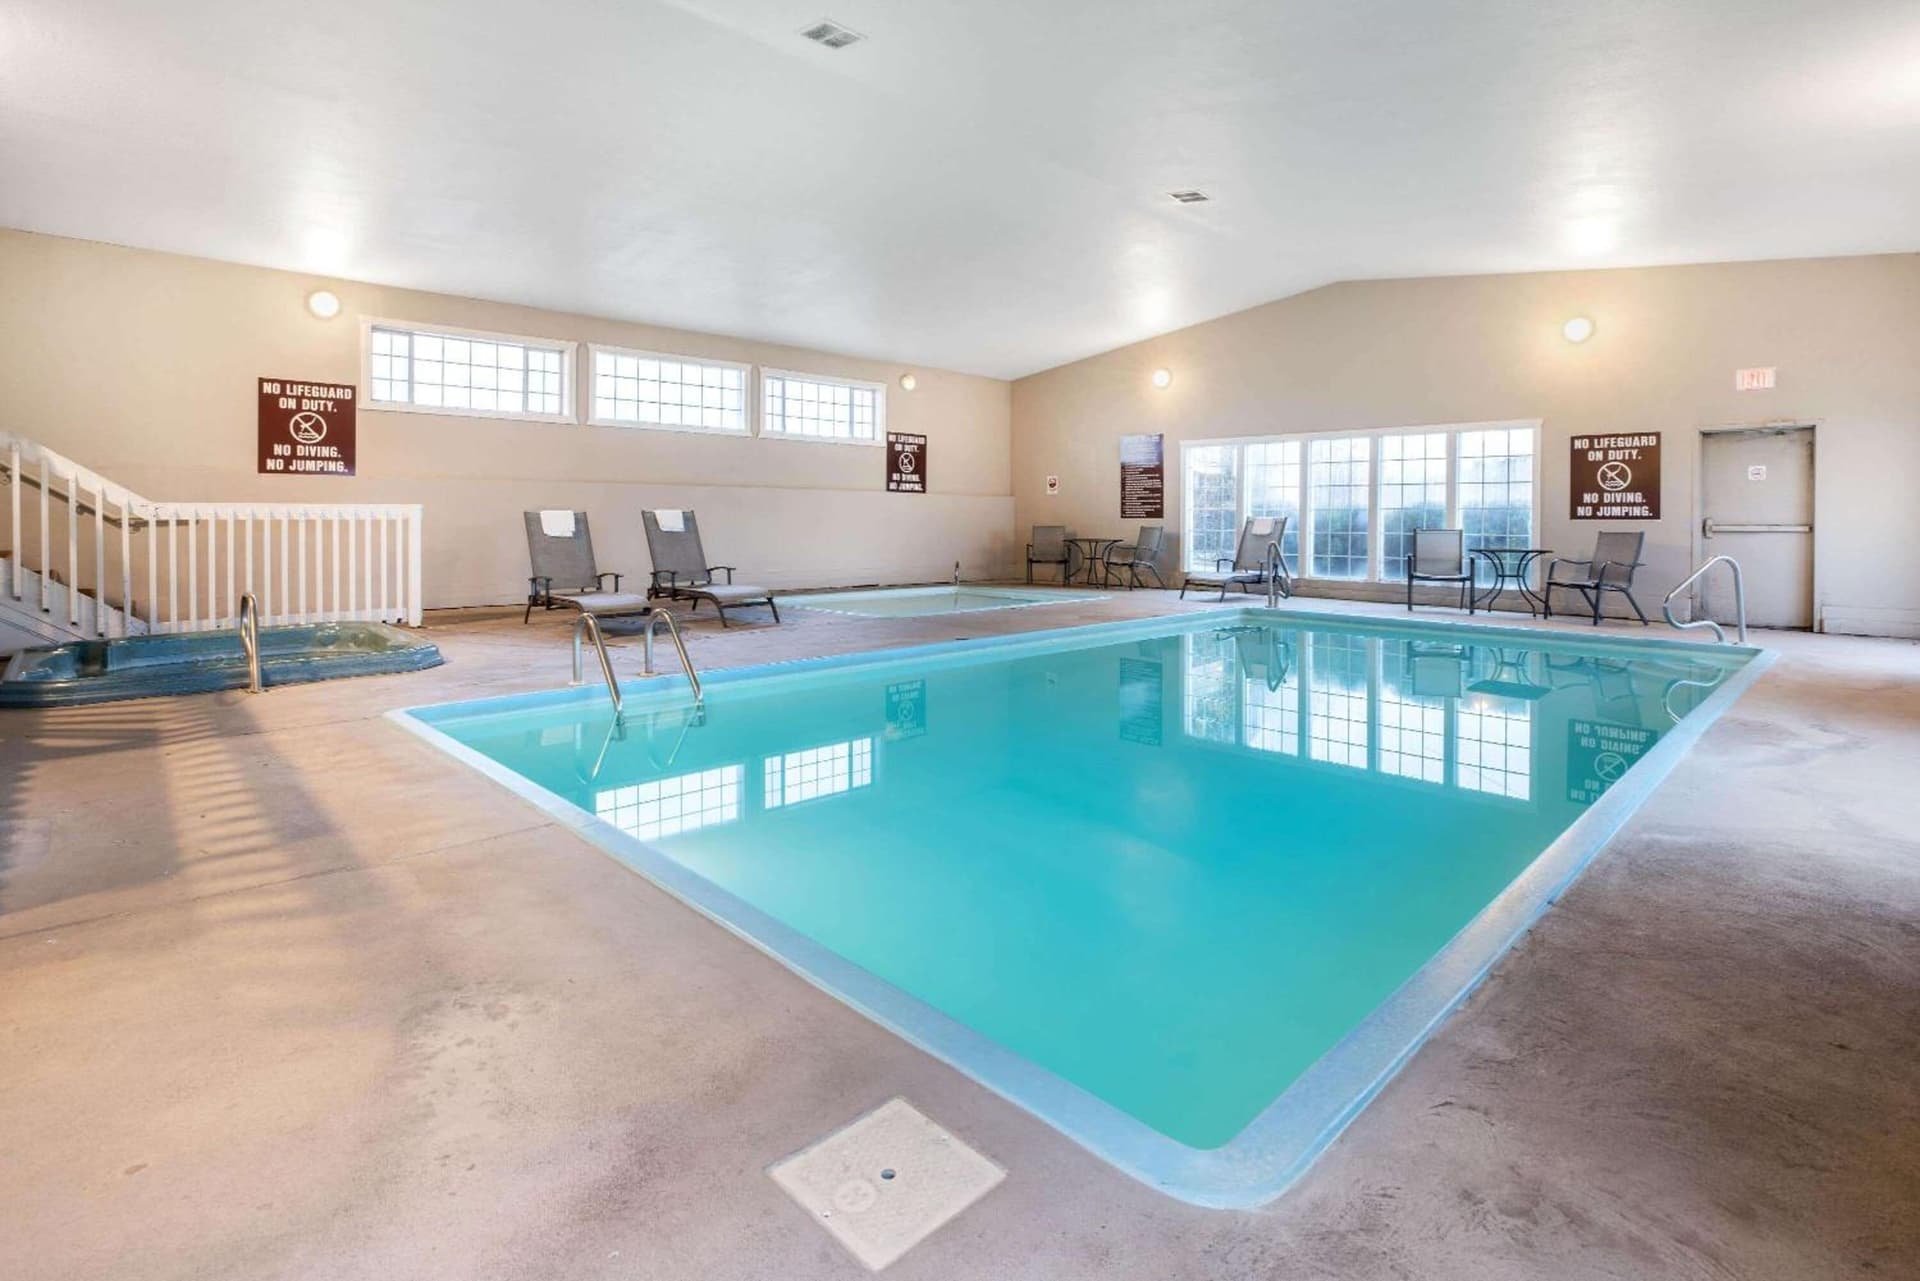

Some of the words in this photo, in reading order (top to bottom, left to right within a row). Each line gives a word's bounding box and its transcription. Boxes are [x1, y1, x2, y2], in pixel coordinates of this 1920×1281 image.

[263, 382, 281, 395] NO
[286, 383, 353, 400] LIFEGUARD
[278, 397, 297, 410] ON
[302, 399, 337, 413] DUTY.
[1574, 438, 1590, 450] NO
[1594, 435, 1657, 449] LIFEGUARD
[273, 443, 291, 456] NO
[296, 445, 341, 458] DIVING.
[1587, 450, 1604, 462] ON
[1608, 449, 1642, 461] DUTY.
[266, 458, 284, 471] NO
[289, 459, 349, 473] JUMPING.
[1583, 492, 1599, 504] NO
[1603, 492, 1646, 503] DIVING.
[1577, 506, 1593, 517] NO
[1597, 505, 1653, 517] JUMPING.
